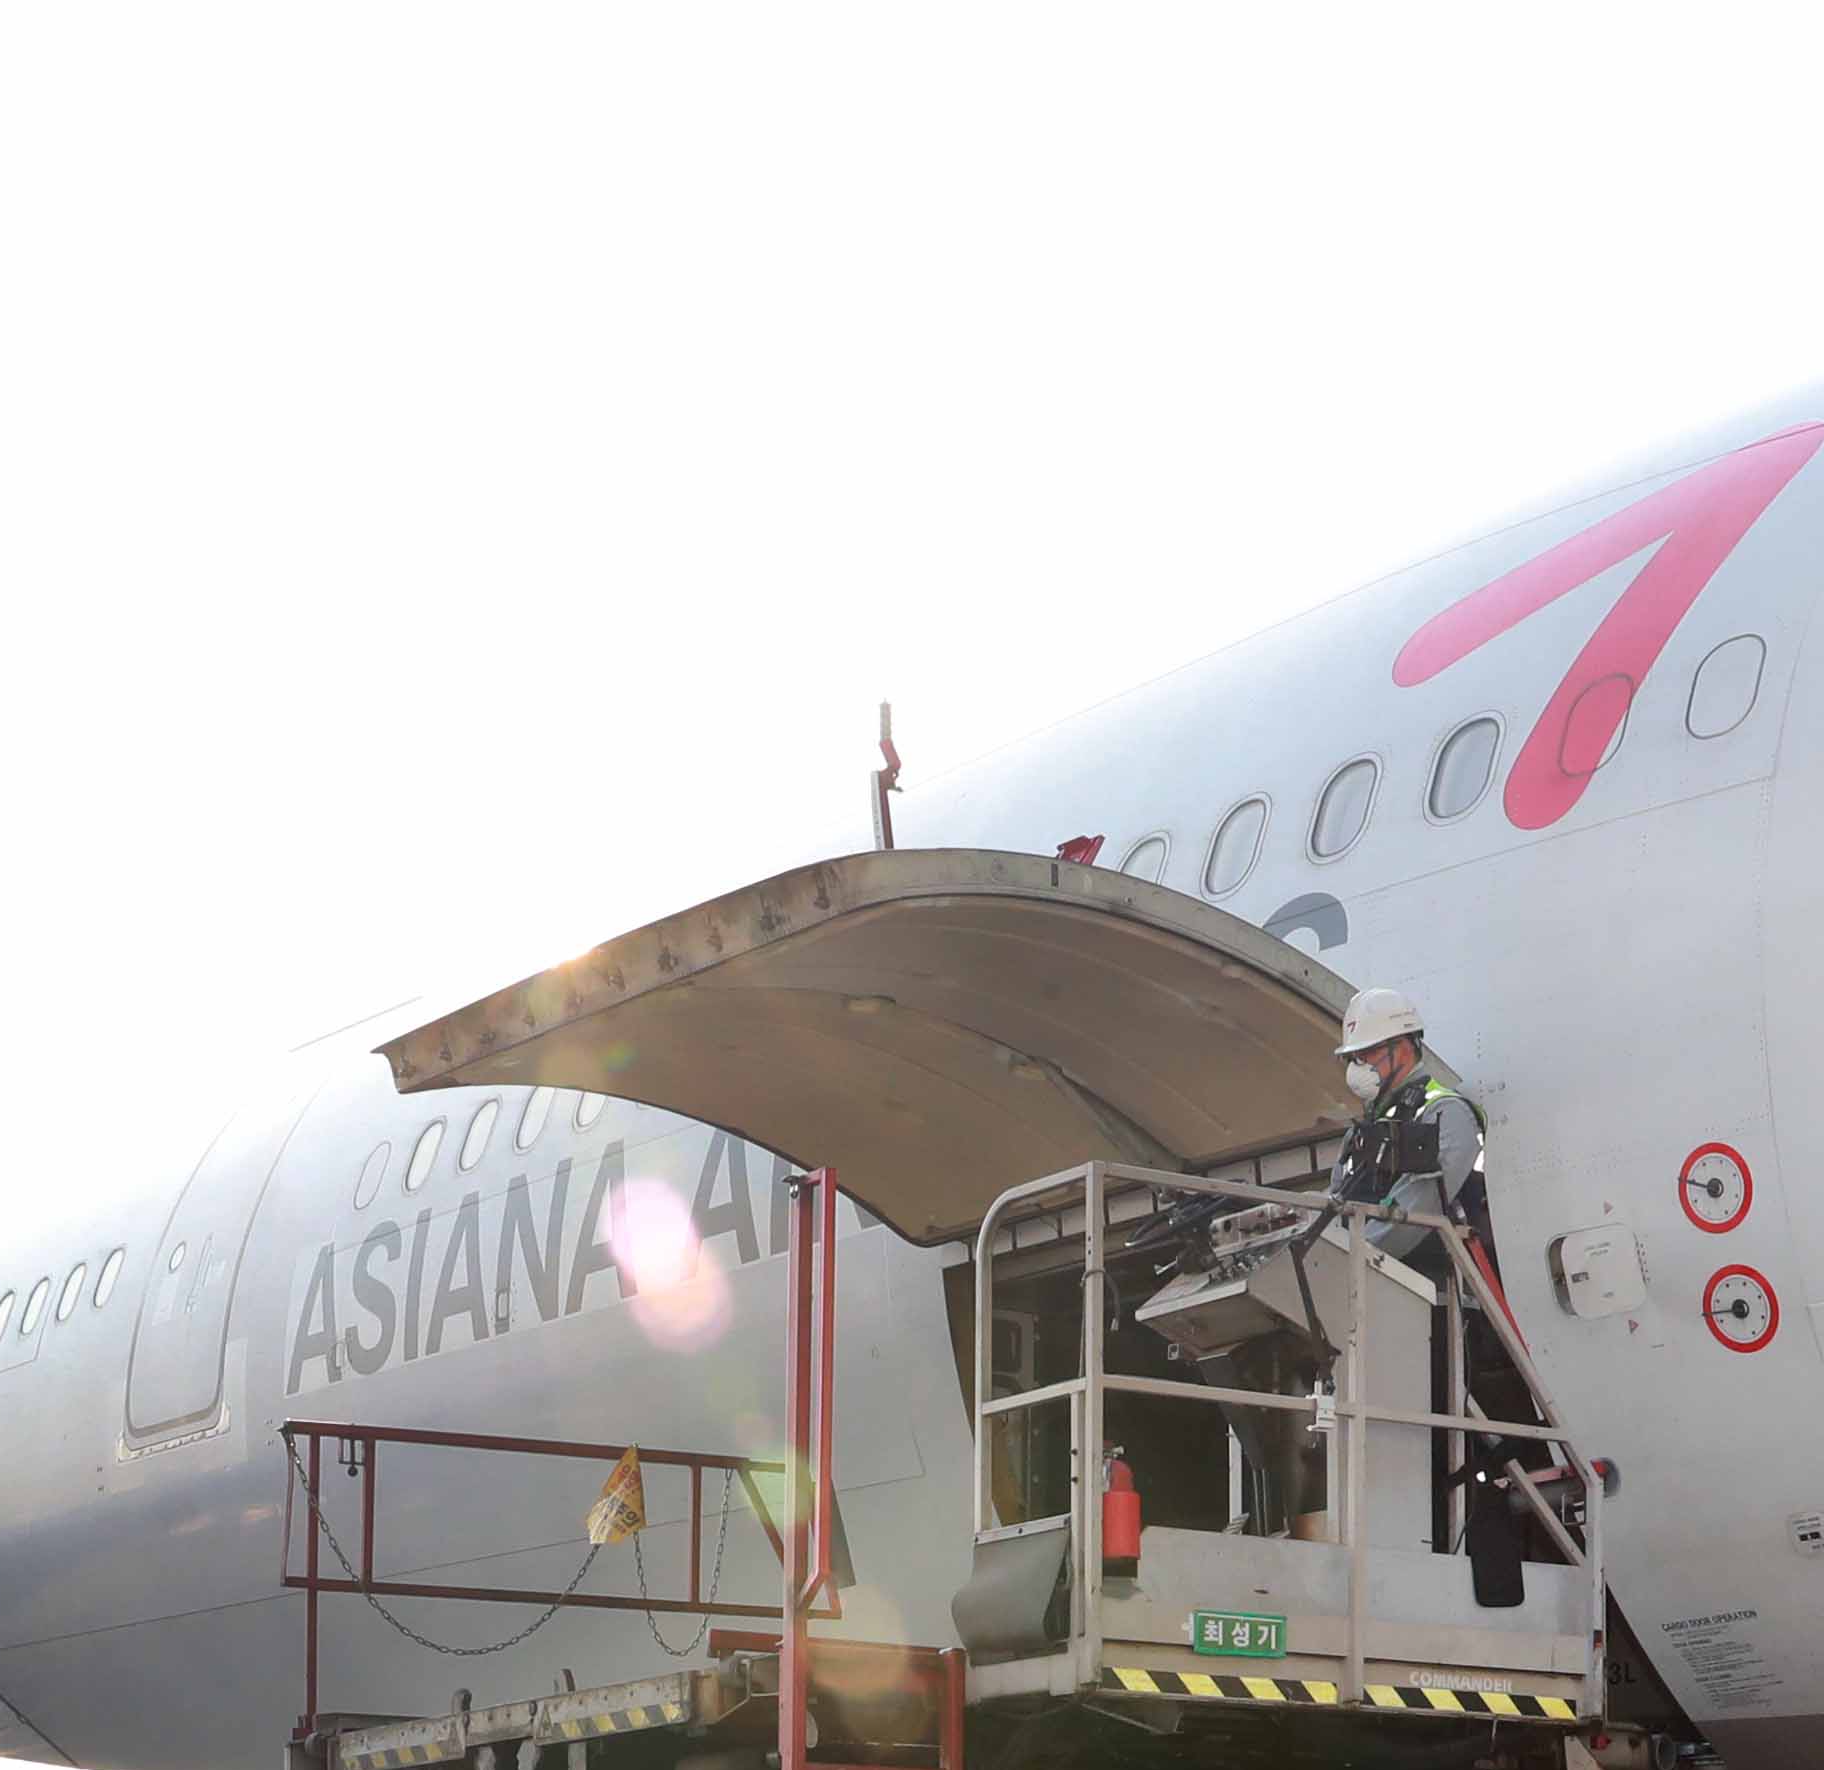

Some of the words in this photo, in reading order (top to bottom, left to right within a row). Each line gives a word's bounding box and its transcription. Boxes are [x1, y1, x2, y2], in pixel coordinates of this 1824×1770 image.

[285, 1137, 638, 1397] ASIANA
[1203, 1619, 1279, 1650] 최성기
[1408, 1670, 1514, 1693] COMMANDER
